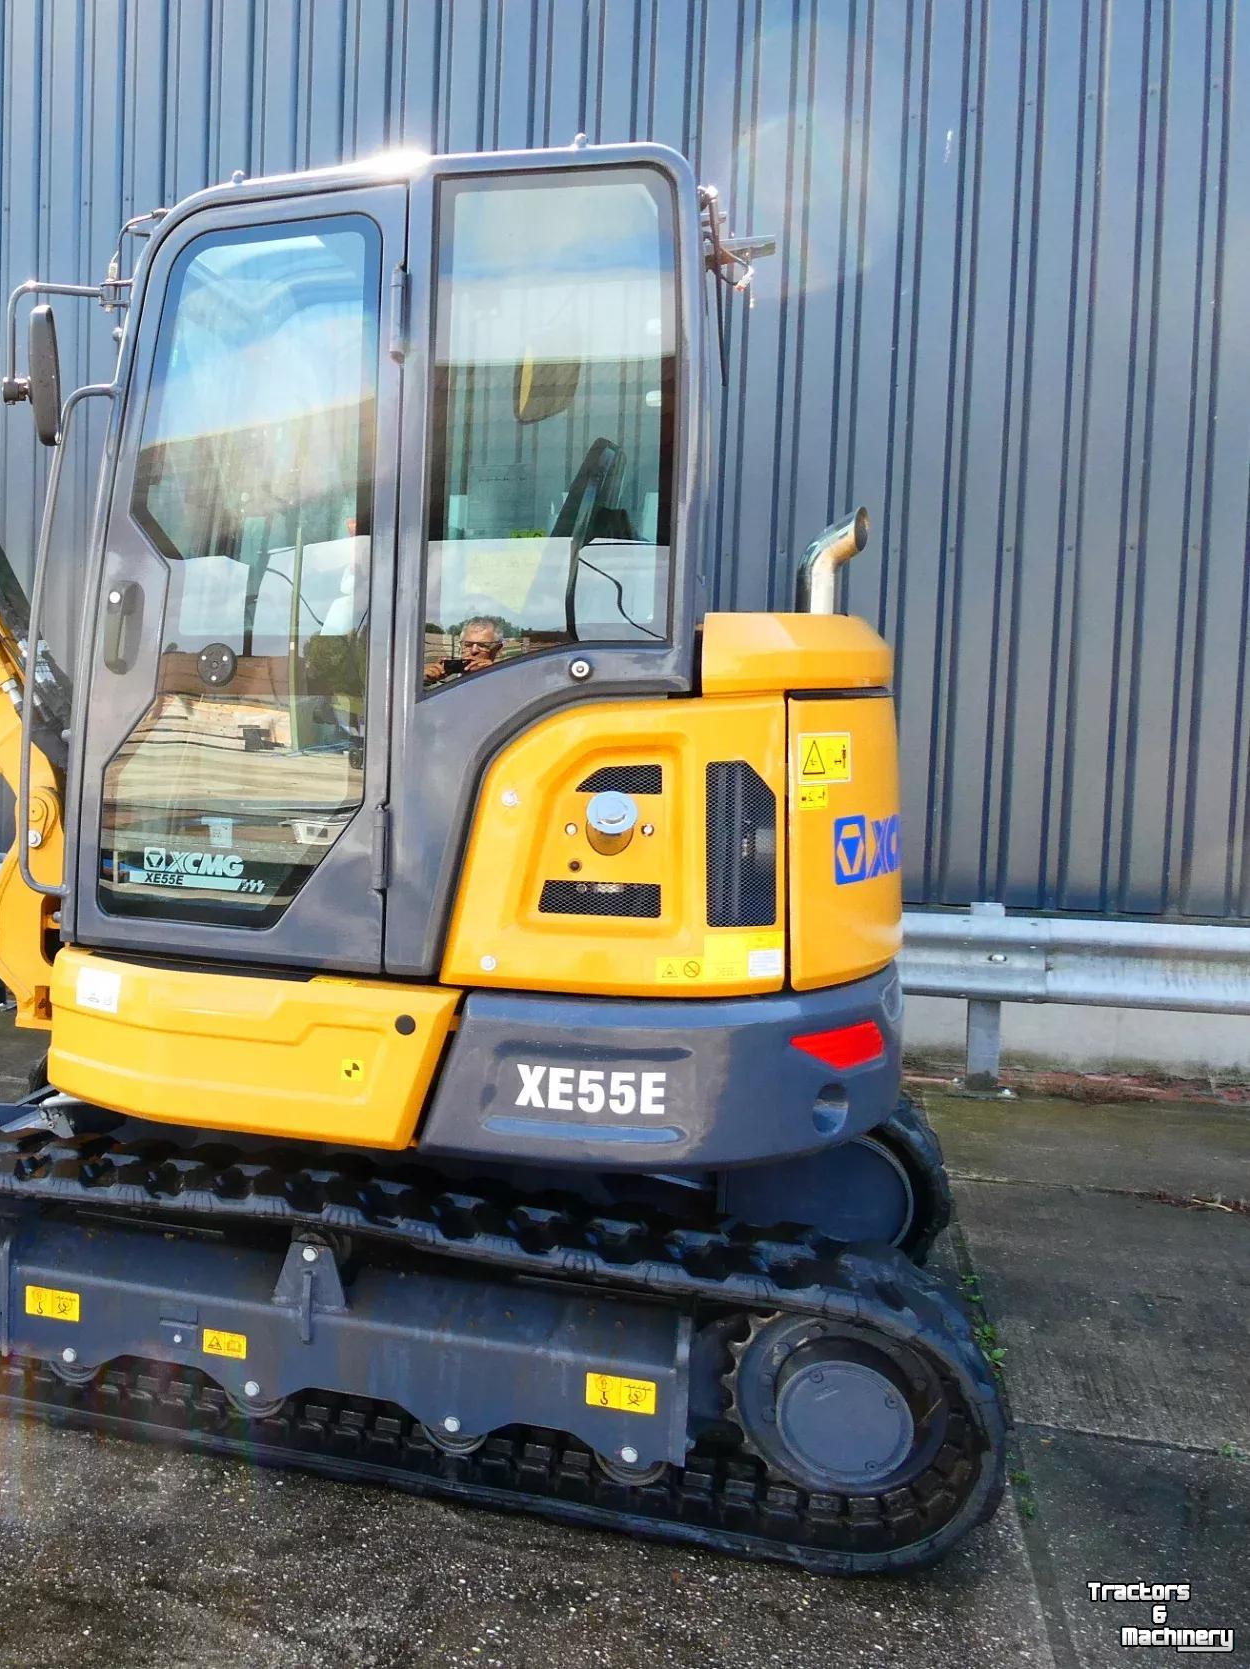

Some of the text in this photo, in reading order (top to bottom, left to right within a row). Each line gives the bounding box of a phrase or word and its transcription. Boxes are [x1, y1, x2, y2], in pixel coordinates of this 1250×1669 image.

[165, 850, 244, 877] XCMG
[144, 872, 184, 886] XE55E
[514, 1063, 667, 1115] XE55E
